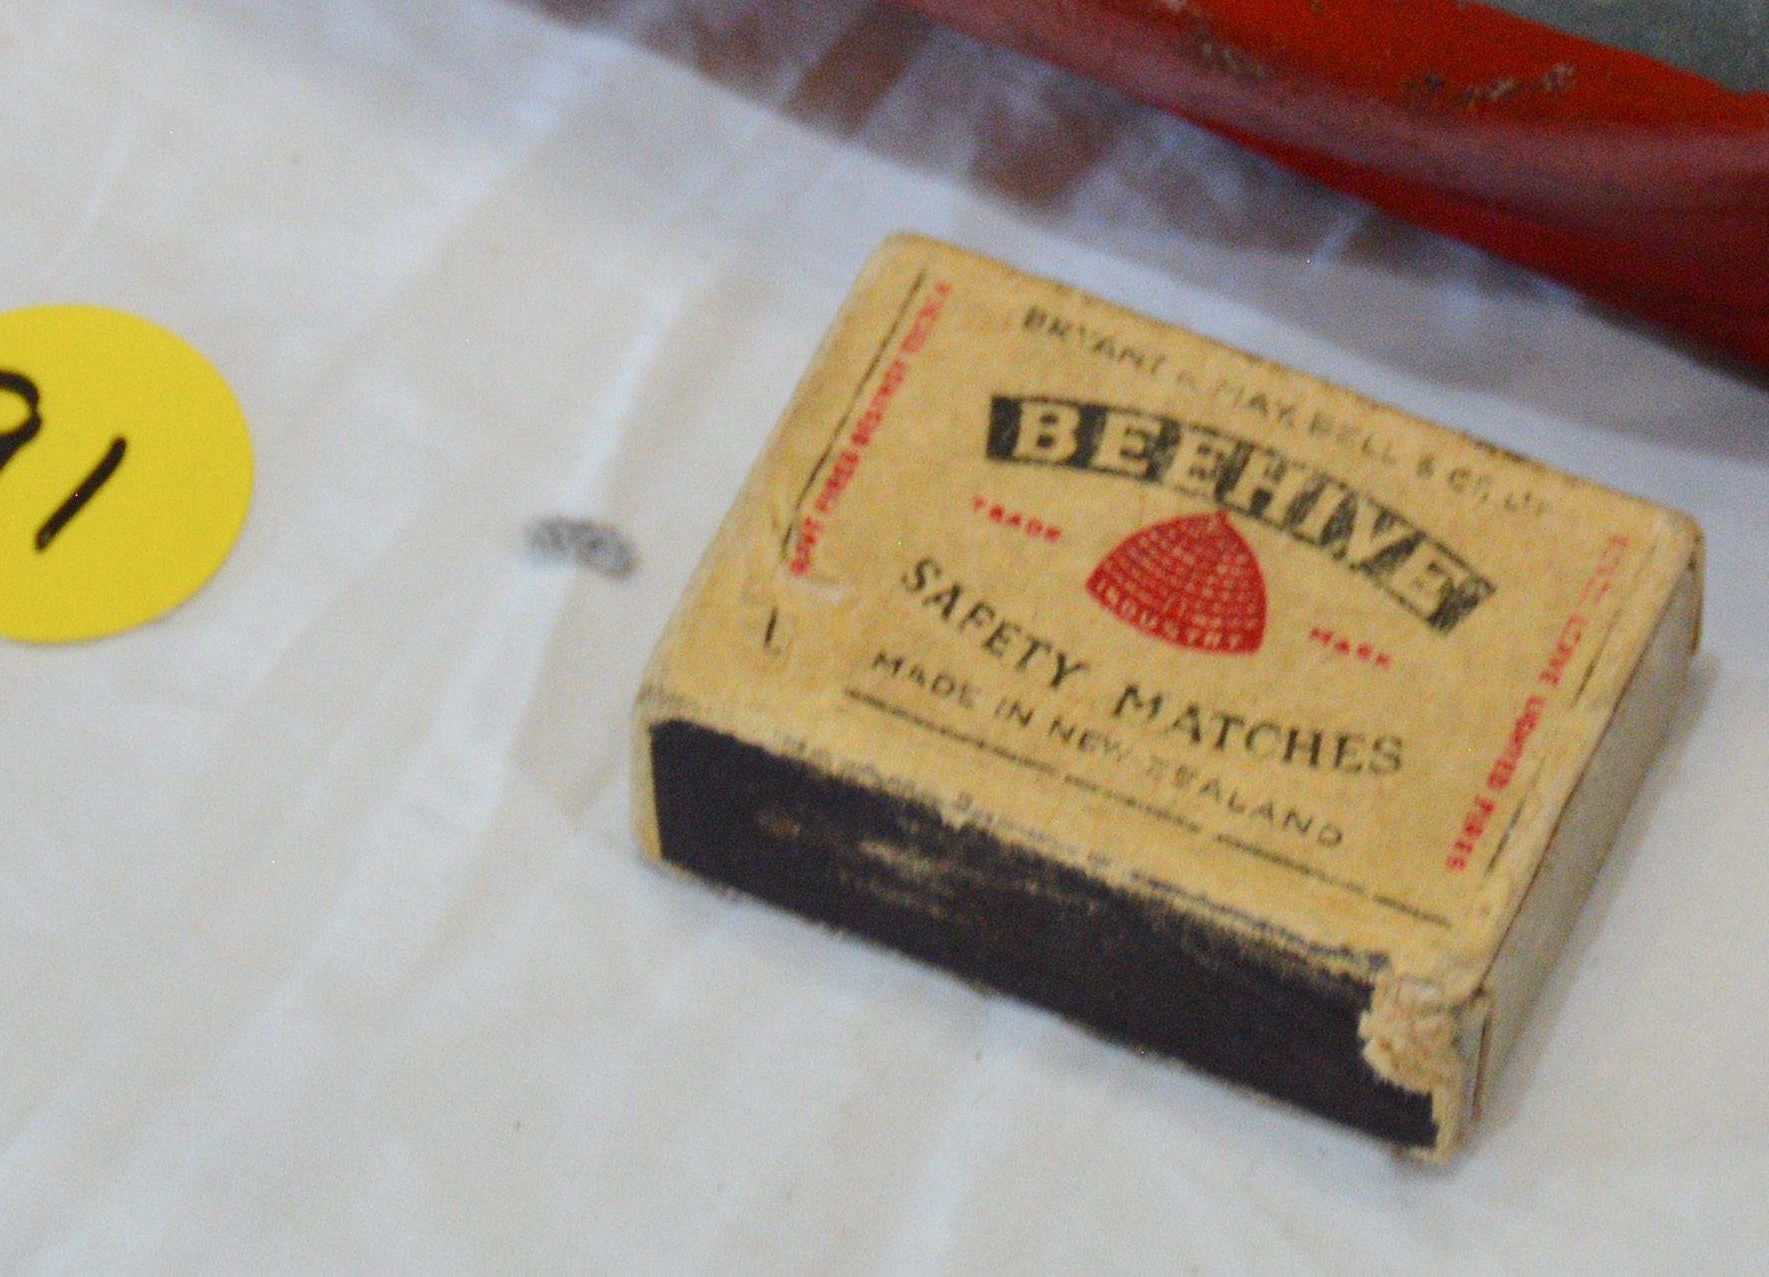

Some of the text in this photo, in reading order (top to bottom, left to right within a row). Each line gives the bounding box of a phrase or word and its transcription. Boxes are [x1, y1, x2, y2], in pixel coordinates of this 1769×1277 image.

[998, 396, 1486, 630] BEEHIVE
[870, 648, 1346, 849] MADE IN NEW ZEALAND
[900, 555, 1406, 777] SAFETY MATCHES
